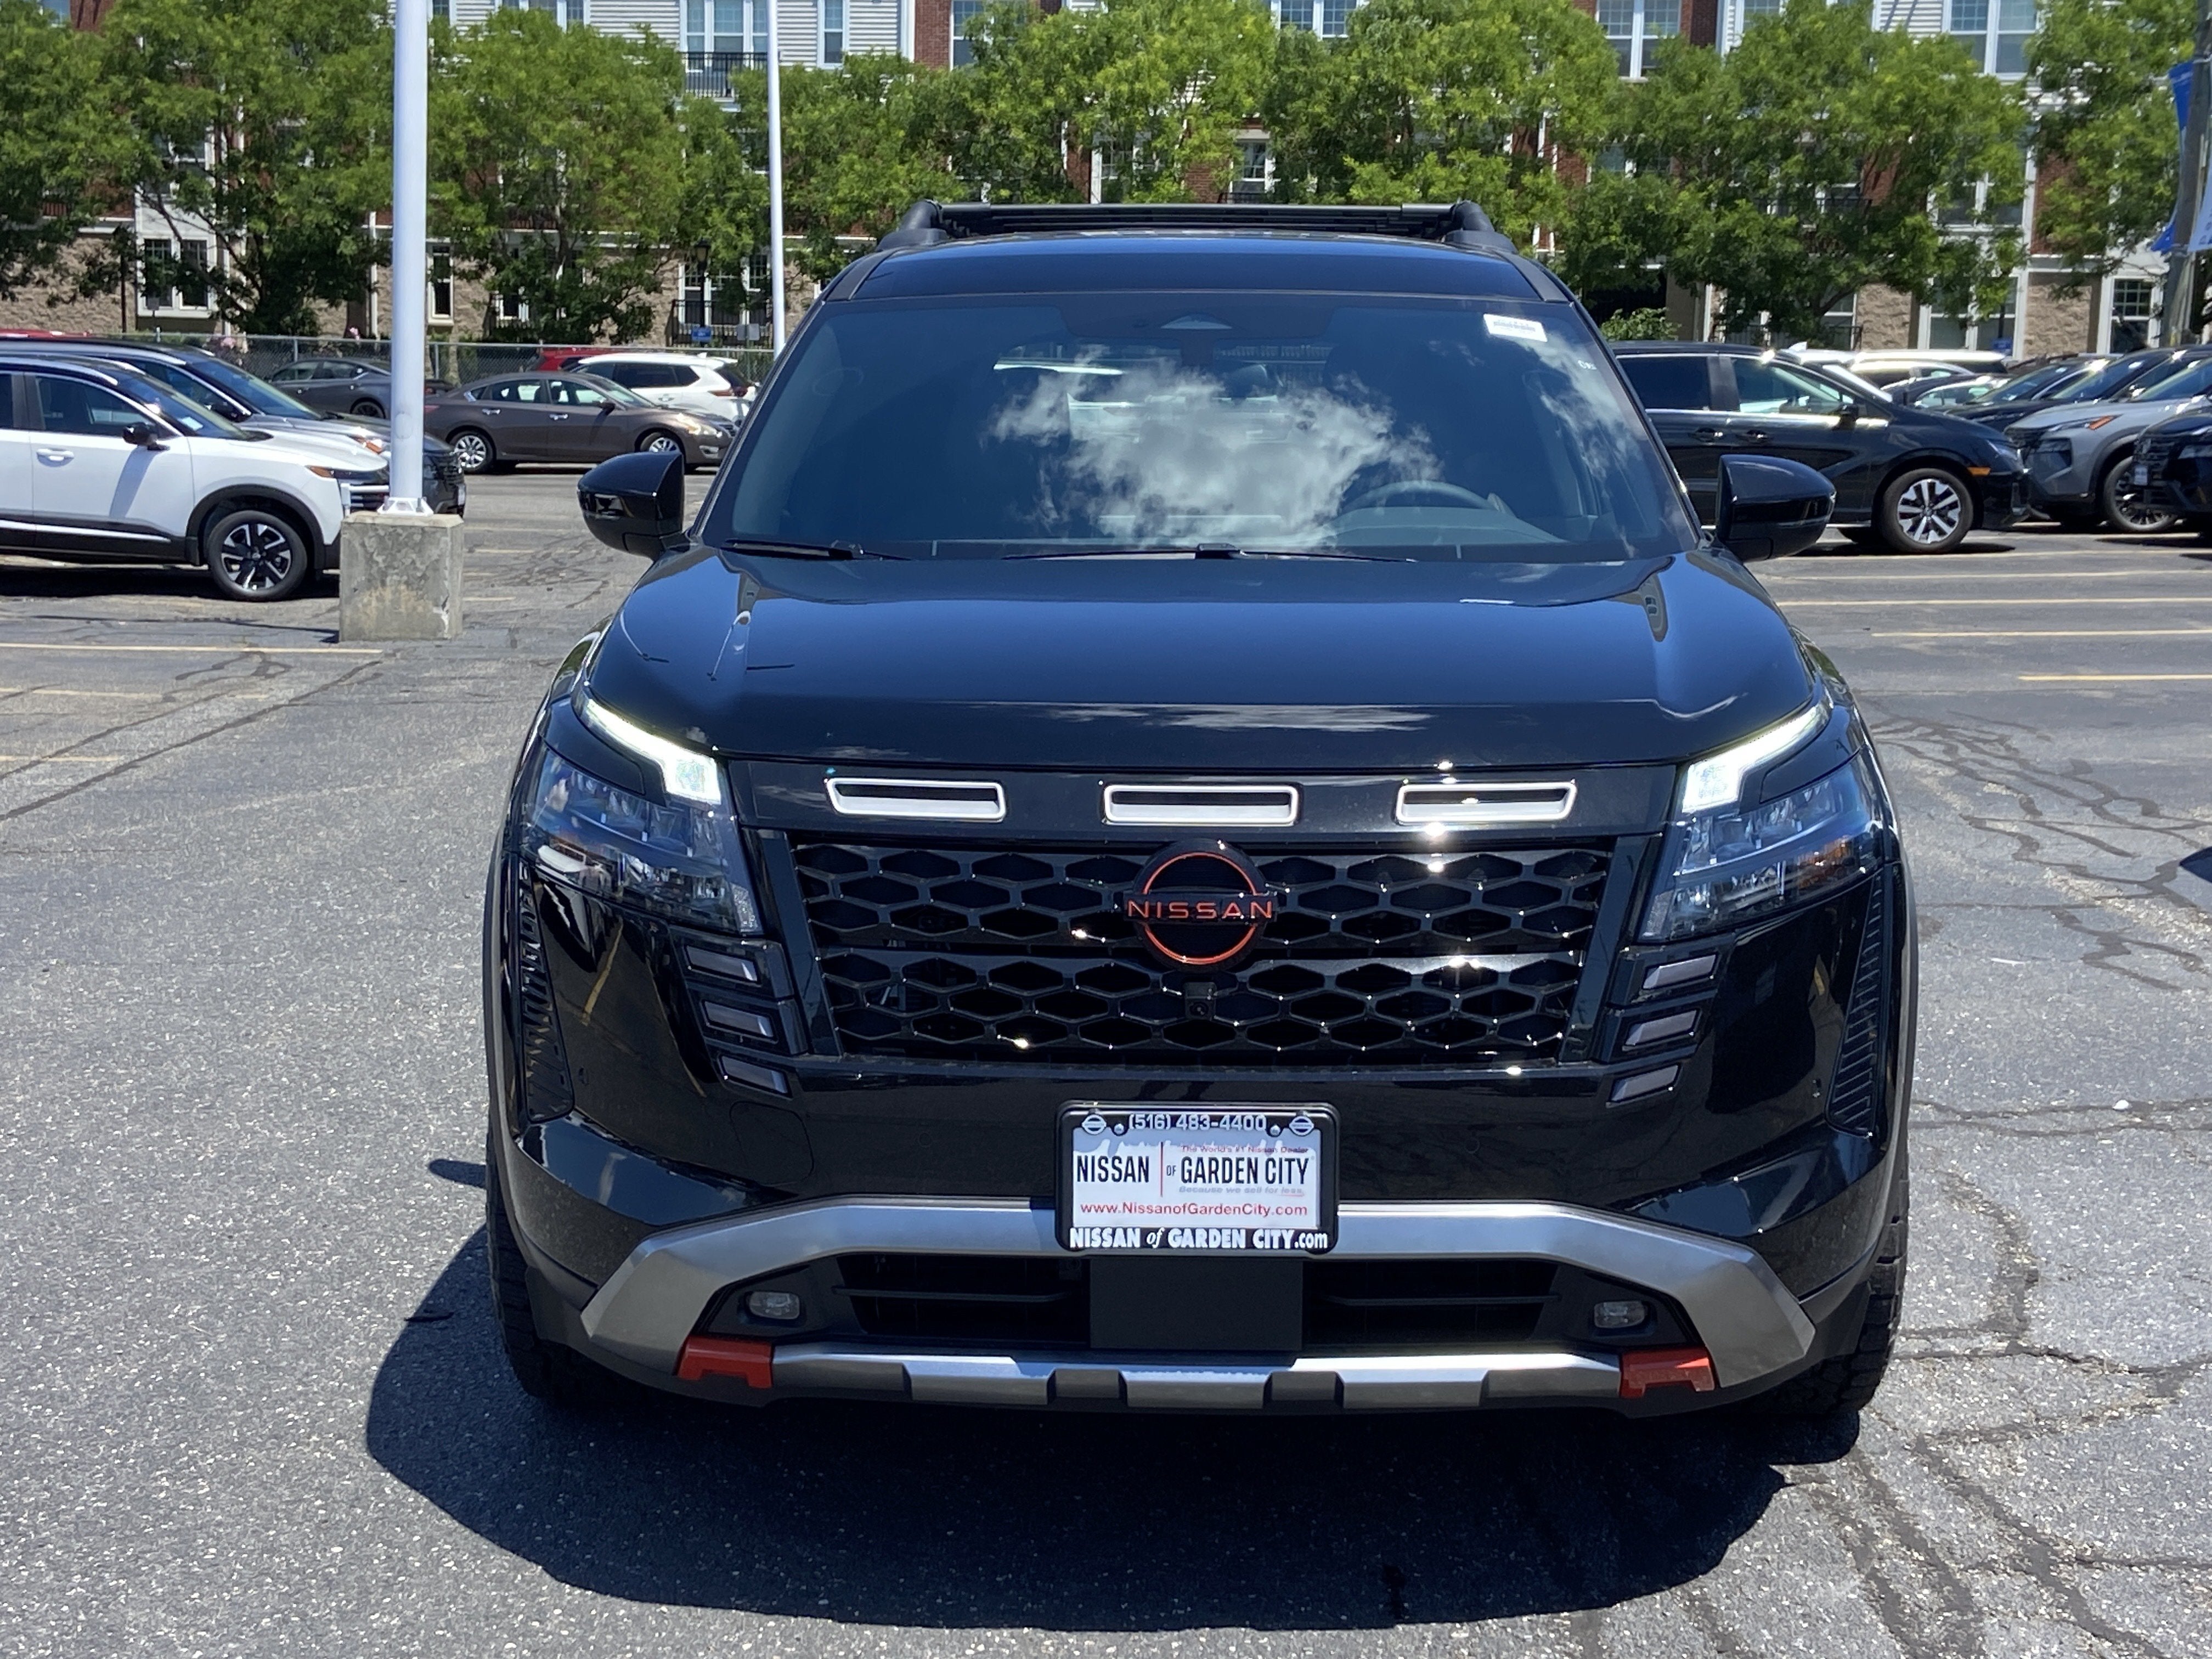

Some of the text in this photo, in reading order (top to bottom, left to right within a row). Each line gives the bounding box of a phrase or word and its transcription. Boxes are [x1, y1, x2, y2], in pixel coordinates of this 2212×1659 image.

[1127, 900, 1273, 919] NISSAN
[1128, 1114, 1267, 1131] (516) 483-4400
[1077, 1155, 1309, 1184] NISSAN OF GARDEN CITY
[1080, 1201, 1307, 1217] www.NissanofGardenCity.com
[1070, 1227, 1141, 1248] NISSAN
[1146, 1227, 1165, 1248] of
[1168, 1228, 1246, 1248] GARDEN
